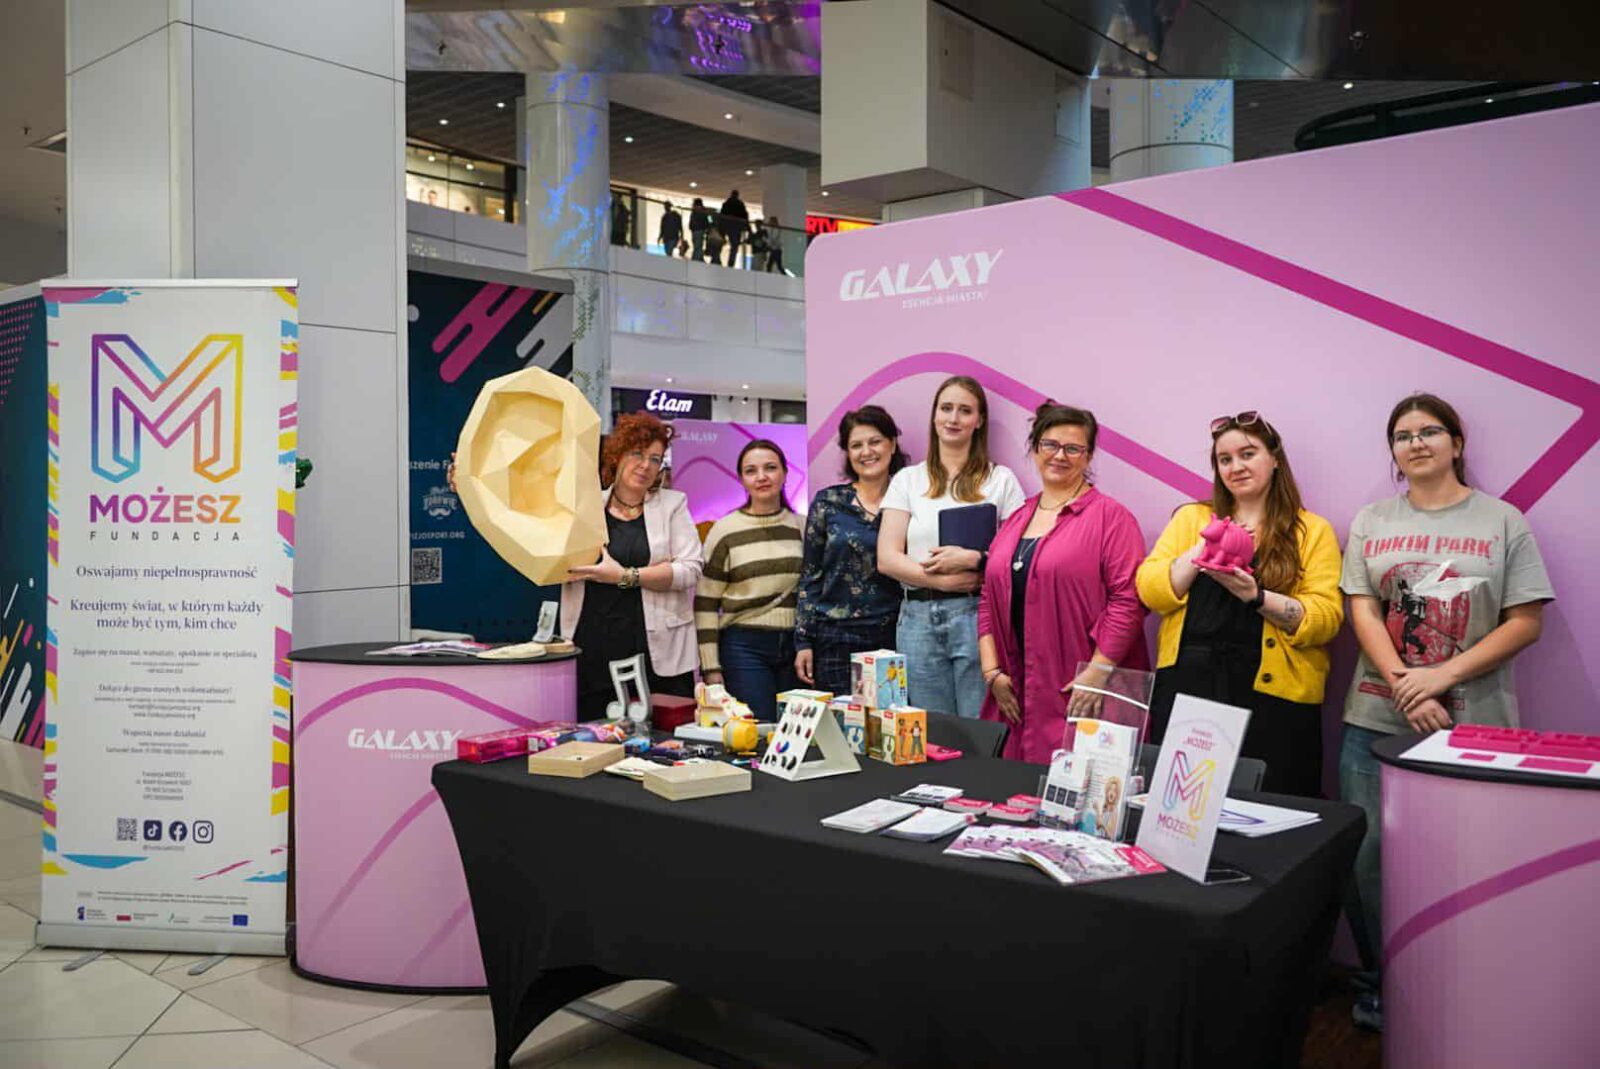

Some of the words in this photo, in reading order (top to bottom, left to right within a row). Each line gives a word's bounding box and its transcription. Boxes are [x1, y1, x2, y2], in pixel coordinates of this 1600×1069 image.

[840, 248, 1004, 301] GALAXY
[645, 389, 693, 412] Etam
[89, 486, 241, 523] MOŻESZ
[90, 531, 241, 541] FUNDACJA
[1434, 536, 1493, 558] PARK
[76, 566, 139, 580] Oswajamy
[70, 599, 128, 614] Kreujemy
[168, 604, 178, 612] w
[181, 599, 225, 615] którym
[227, 600, 264, 616] każdy
[96, 617, 128, 629] może
[132, 617, 151, 631] być
[184, 617, 207, 629] kim
[210, 617, 237, 629] chce
[348, 728, 462, 750] GALAXY
